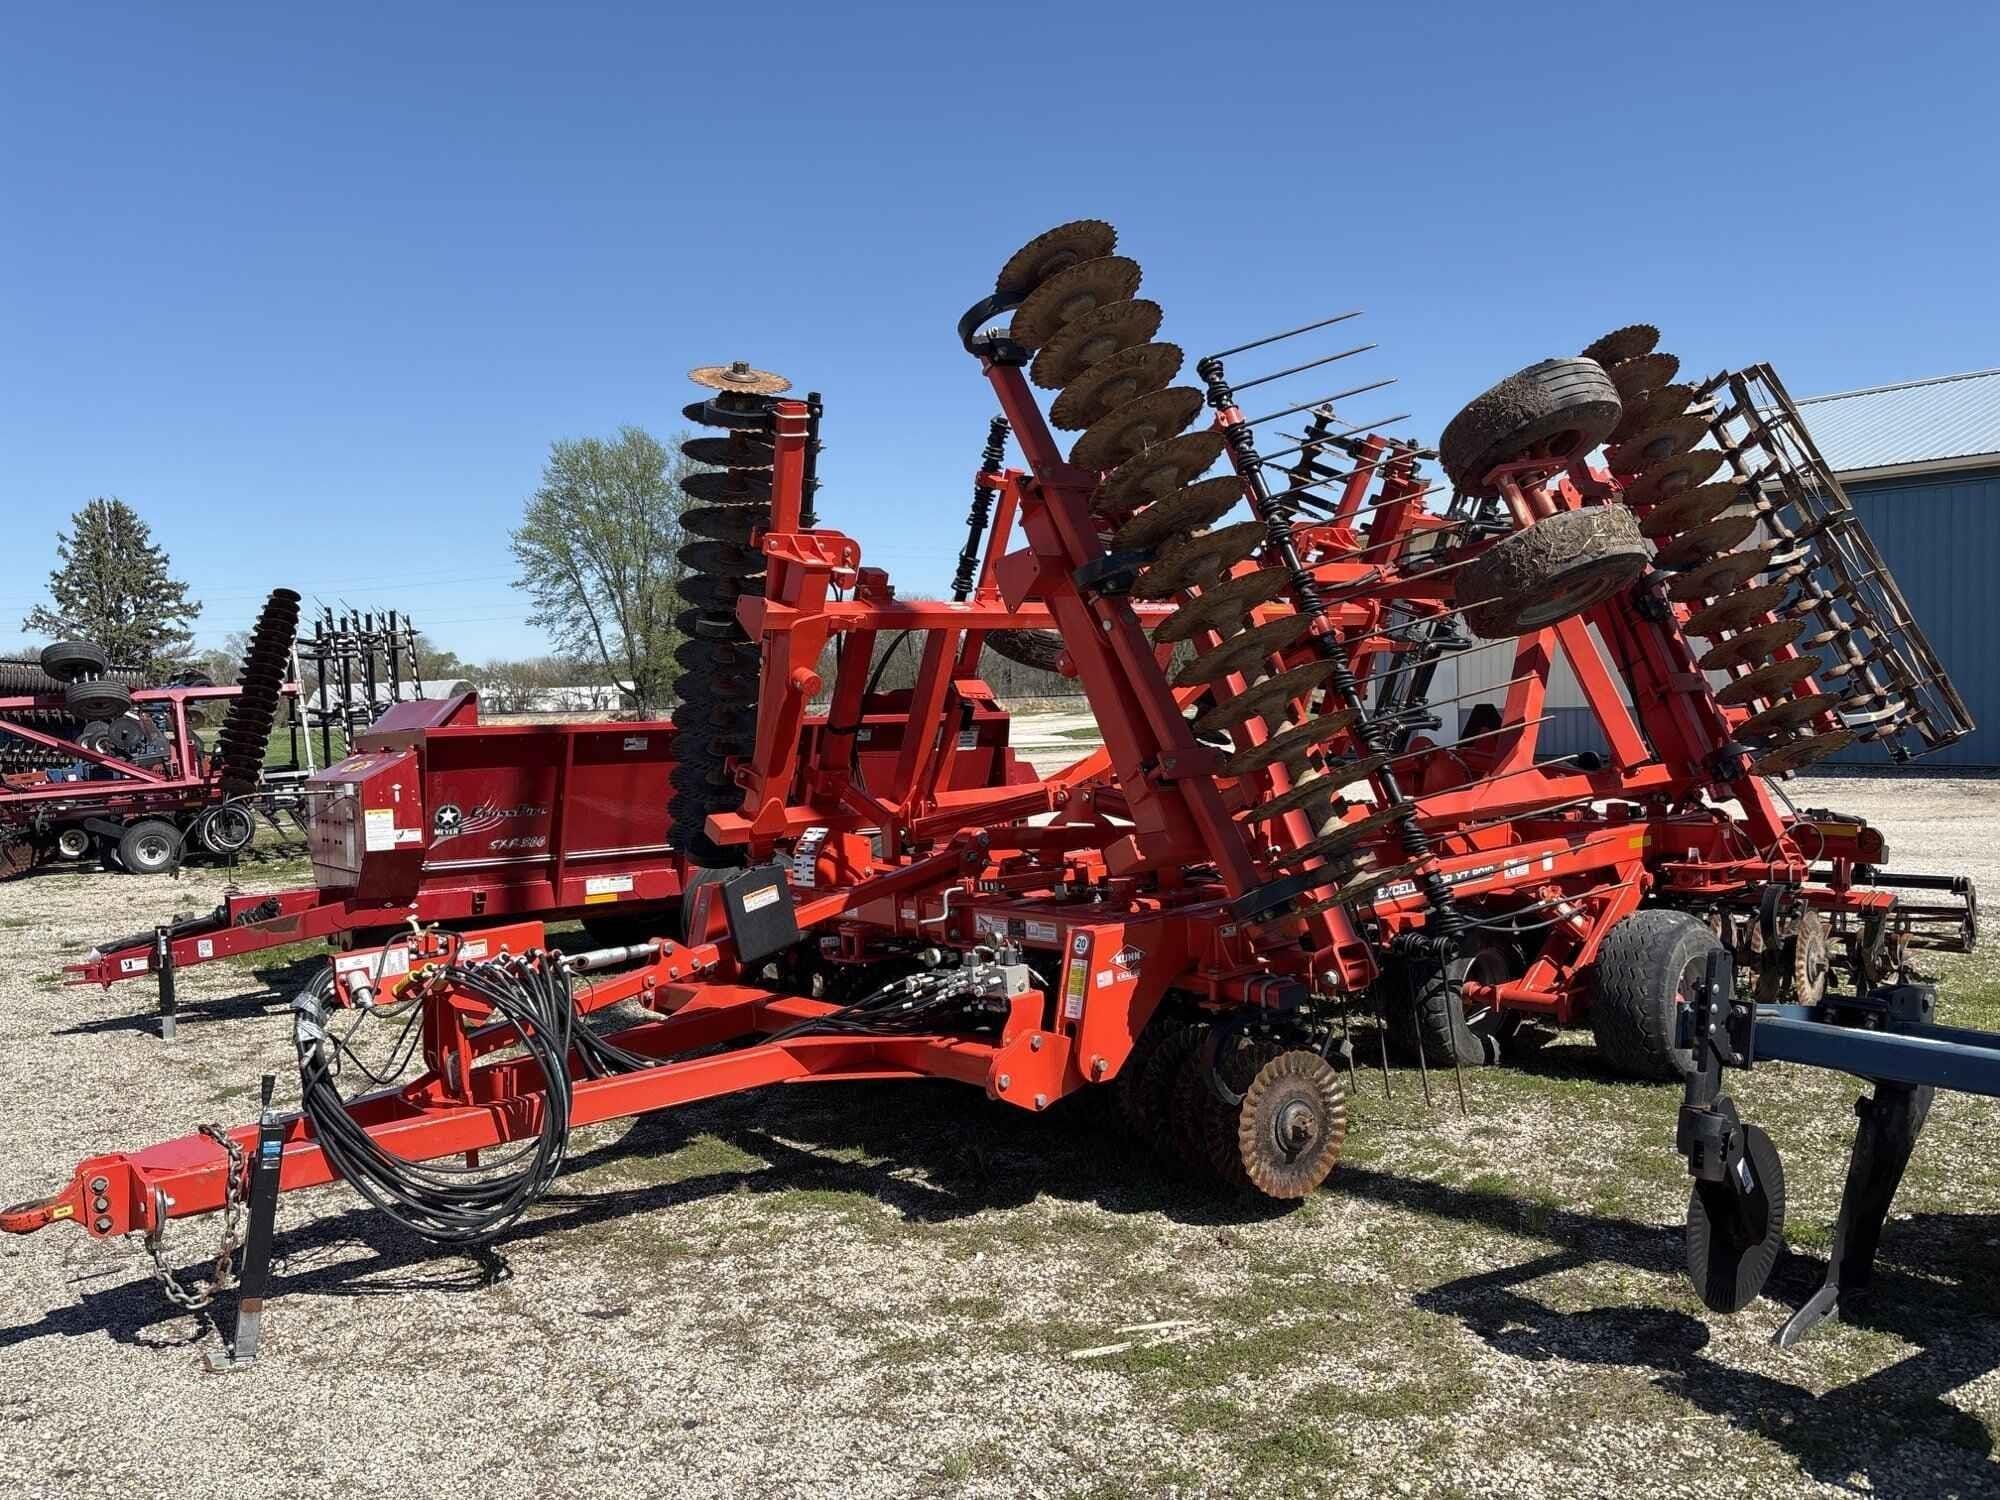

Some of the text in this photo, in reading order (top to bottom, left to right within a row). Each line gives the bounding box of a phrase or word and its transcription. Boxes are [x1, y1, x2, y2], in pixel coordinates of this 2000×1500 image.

[434, 827, 460, 836] MEYER
[1076, 937, 1087, 949] 20
[1114, 951, 1142, 965] KUHN
